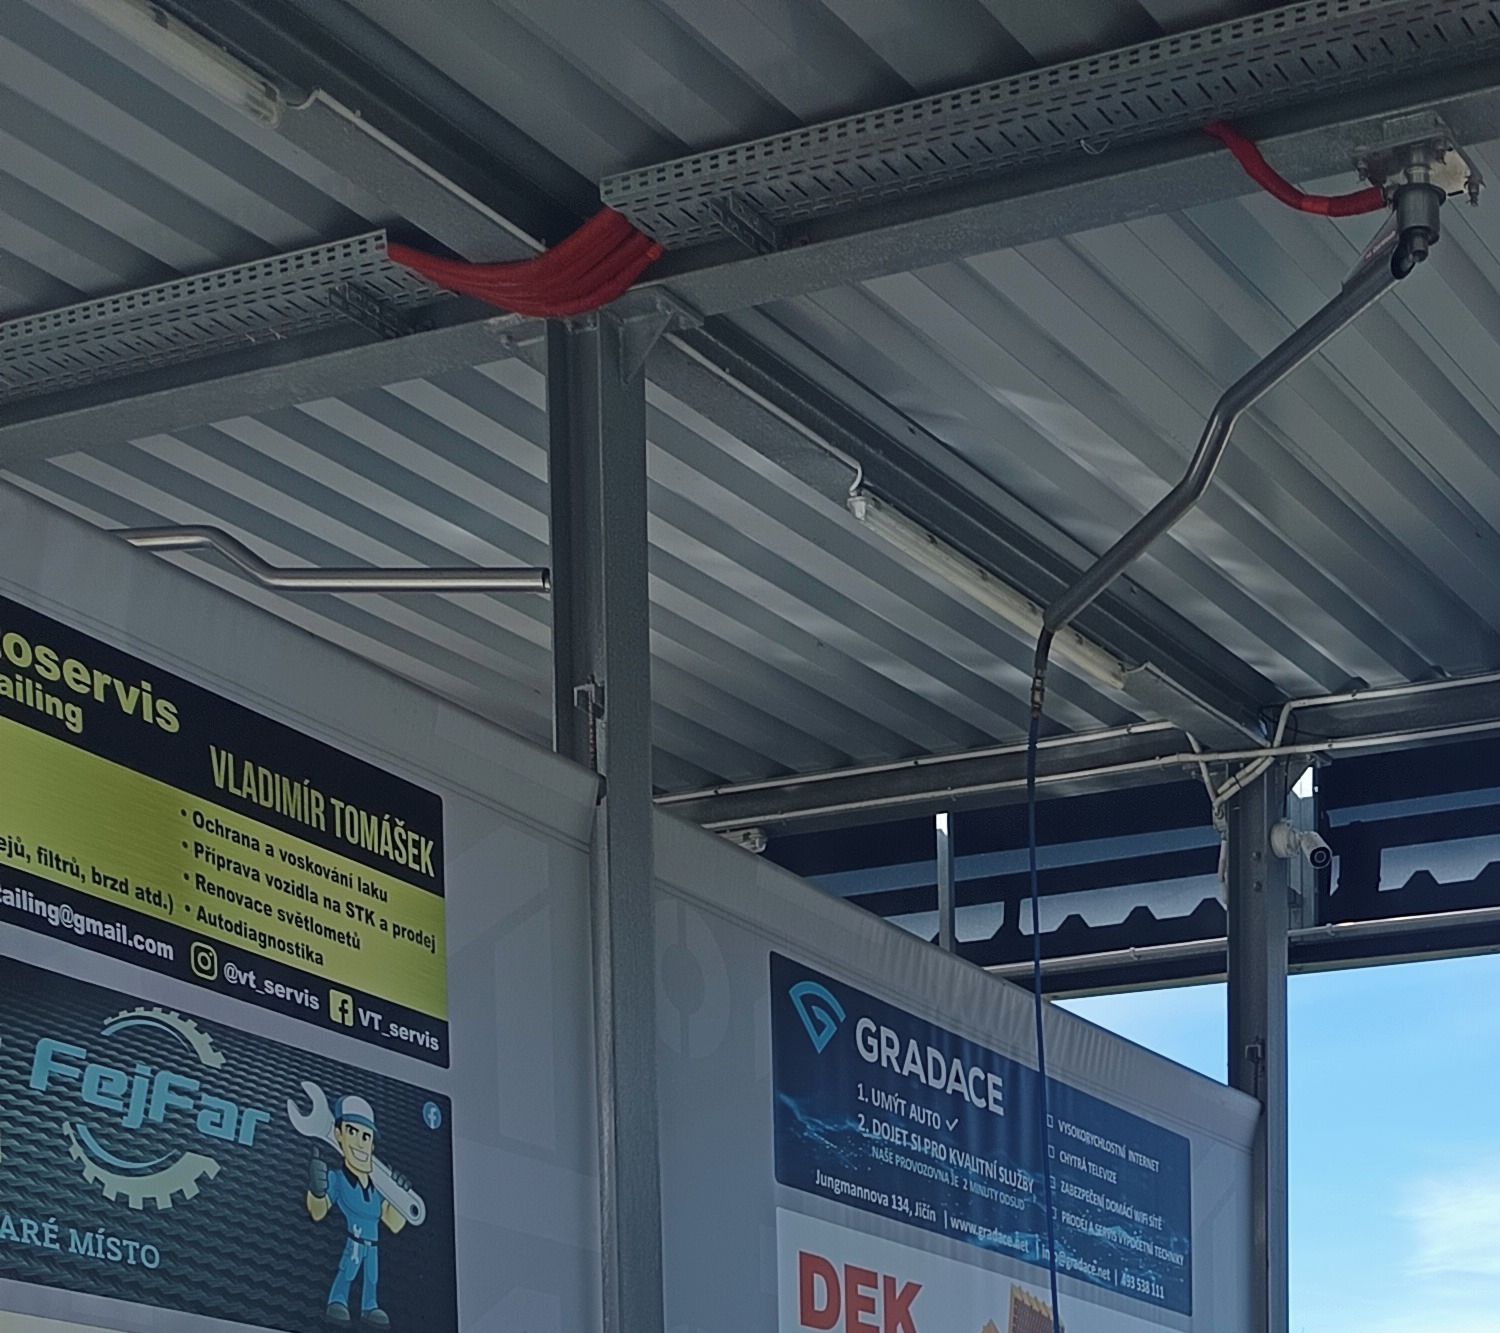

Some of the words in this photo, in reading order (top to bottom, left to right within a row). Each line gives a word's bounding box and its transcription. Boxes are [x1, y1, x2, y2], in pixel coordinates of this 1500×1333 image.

[0, 631, 181, 734] oservis
[208, 744, 327, 832] VLADIMÍR
[330, 797, 436, 878] TOMÁŠEK
[36, 845, 87, 884] filtrů,
[91, 865, 130, 896] brzd
[135, 885, 175, 916] atd.)
[192, 810, 261, 853] Ochrana
[265, 841, 275, 857] a
[279, 846, 353, 888] voskování
[357, 876, 388, 904] laku
[193, 840, 261, 882] Příprava
[265, 872, 319, 906] vozidla
[323, 897, 341, 915] na
[346, 901, 377, 928] STK
[379, 917, 389, 932] a
[392, 919, 437, 954] prodej
[194, 872, 273, 918] Renovace
[277, 907, 362, 951] světlometů
[196, 904, 326, 968] Autodiagnostika
[223, 961, 321, 1011] @vt_servis
[357, 1006, 441, 1052] VT_servis
[29, 1037, 272, 1147] FejFar
[855, 1016, 1005, 1118] GRADACE
[857, 1082, 869, 1103] 1.
[871, 1088, 908, 1115] UMÝT
[909, 1102, 942, 1131] AUTO
[857, 1113, 870, 1134] 2.
[872, 1119, 909, 1147] DOJET
[911, 1133, 922, 1153] SI
[923, 1137, 948, 1161] PRO
[949, 1147, 998, 1183] KVALITNÍ
[998, 1165, 1035, 1195] SLUŽBY
[871, 1146, 895, 1166] NAŠE
[895, 1154, 950, 1185] PROVOZOVNA
[1059, 1150, 1088, 1172] CHYTRÁ
[1088, 1161, 1118, 1185] TELEVIZE
[1127, 1149, 1160, 1174] INTERNET
[68, 1227, 161, 1270] MÍSTO
[815, 1168, 889, 1208] Jungmannova
[890, 1193, 913, 1217] 134,
[914, 1200, 937, 1223] Jičín
[1041, 1244, 1111, 1282] in@gradace.net
[1151, 1281, 1165, 1299] 111
